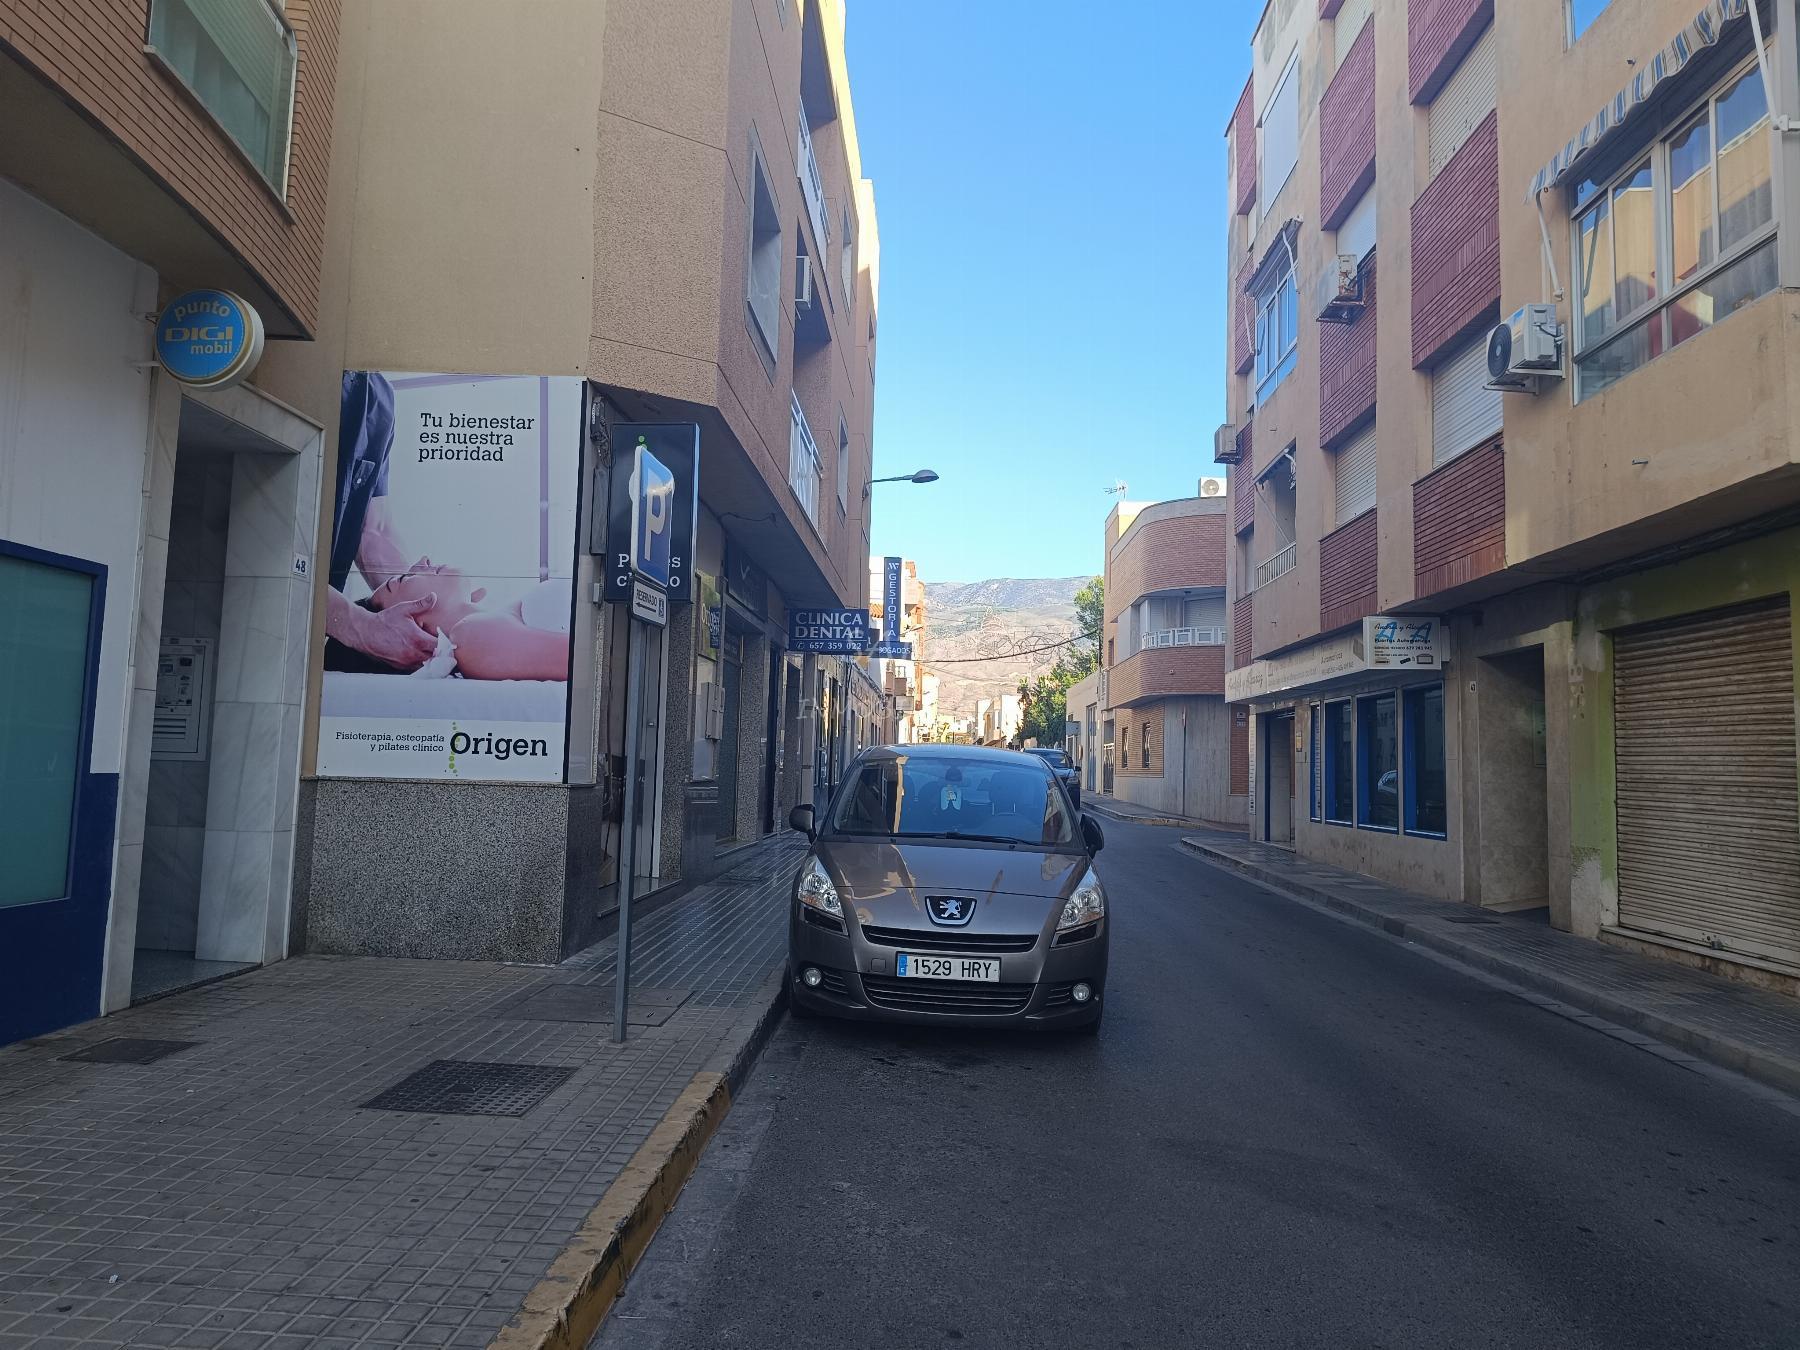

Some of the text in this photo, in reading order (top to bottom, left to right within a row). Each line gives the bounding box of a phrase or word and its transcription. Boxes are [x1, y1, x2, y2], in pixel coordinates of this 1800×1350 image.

[174, 300, 231, 322] punto
[165, 327, 233, 341] DIGI
[191, 341, 232, 354] mobil
[420, 412, 535, 430] Tu bienestar
[419, 431, 514, 446] es nuestra
[418, 445, 504, 462] prioridad
[295, 558, 306, 573] 48
[795, 612, 863, 626] CLINICA
[794, 626, 865, 640] DENTAL
[809, 642, 824, 651] 657
[827, 642, 843, 651] 359
[879, 646, 911, 655] BOGADOS
[335, 732, 394, 741] Fisioterapia,
[450, 732, 548, 761] Origen
[378, 743, 410, 752] pilates
[913, 958, 952, 976] 1529
[961, 961, 992, 978] HRY
